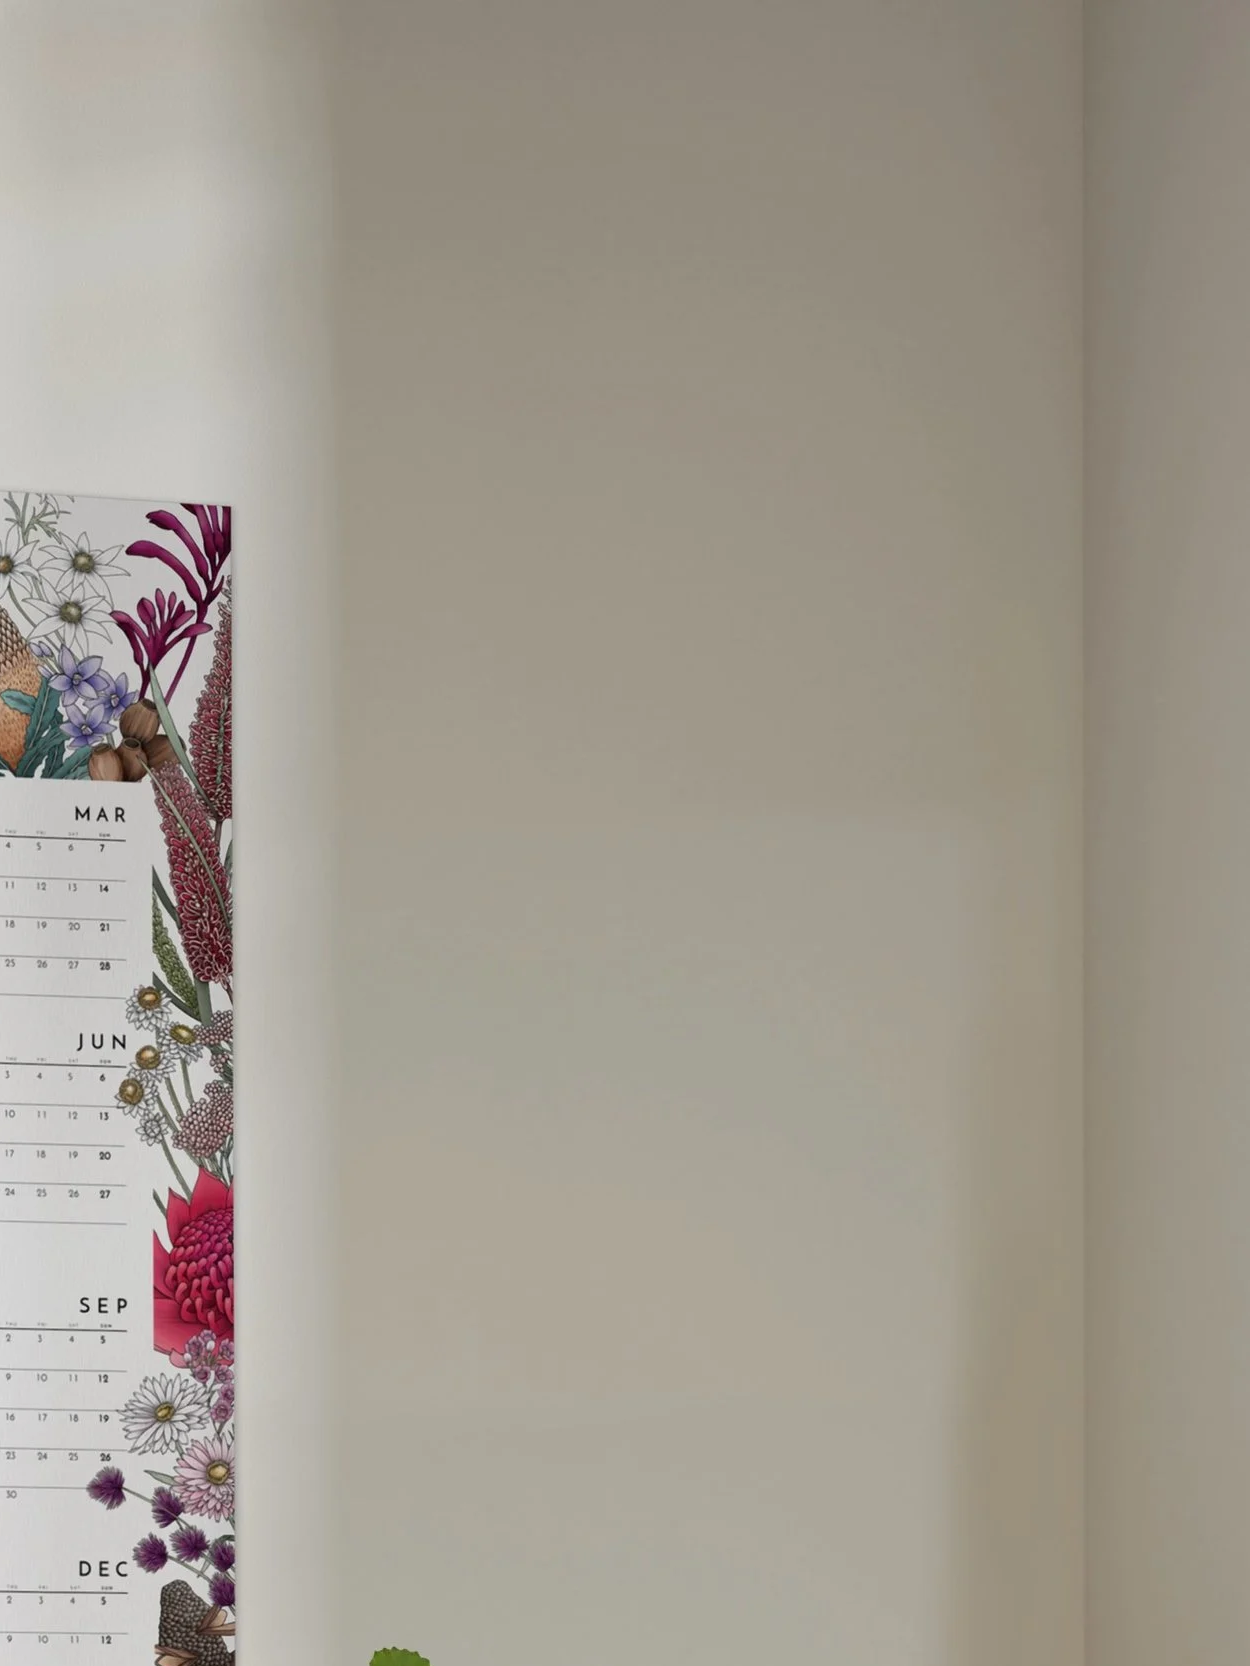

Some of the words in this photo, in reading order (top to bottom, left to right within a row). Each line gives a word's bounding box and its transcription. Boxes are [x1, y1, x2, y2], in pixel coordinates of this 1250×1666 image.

[74, 805, 126, 823] MAR
[5, 880, 15, 890] 11
[36, 881, 47, 892] 12
[68, 882, 78, 893] 13
[98, 883, 110, 893] 14
[99, 922, 111, 933] 21
[99, 961, 112, 971] 28
[76, 1032, 127, 1052] JUN
[98, 1111, 110, 1122] 13
[4, 1148, 15, 1158] 17
[36, 1149, 47, 1159] 18
[68, 1150, 79, 1159] 19
[98, 1150, 112, 1161] 20
[98, 1188, 112, 1200] 27
[79, 1296, 128, 1314] SEP
[97, 1373, 109, 1384] 12
[5, 1412, 16, 1422] 16
[37, 1412, 48, 1422] 17
[69, 1413, 80, 1423] 18
[98, 1413, 110, 1424] 19
[99, 1452, 112, 1463] 26
[5, 1489, 18, 1500] 30
[78, 1560, 128, 1578] DEC
[101, 1634, 112, 1645] 12
